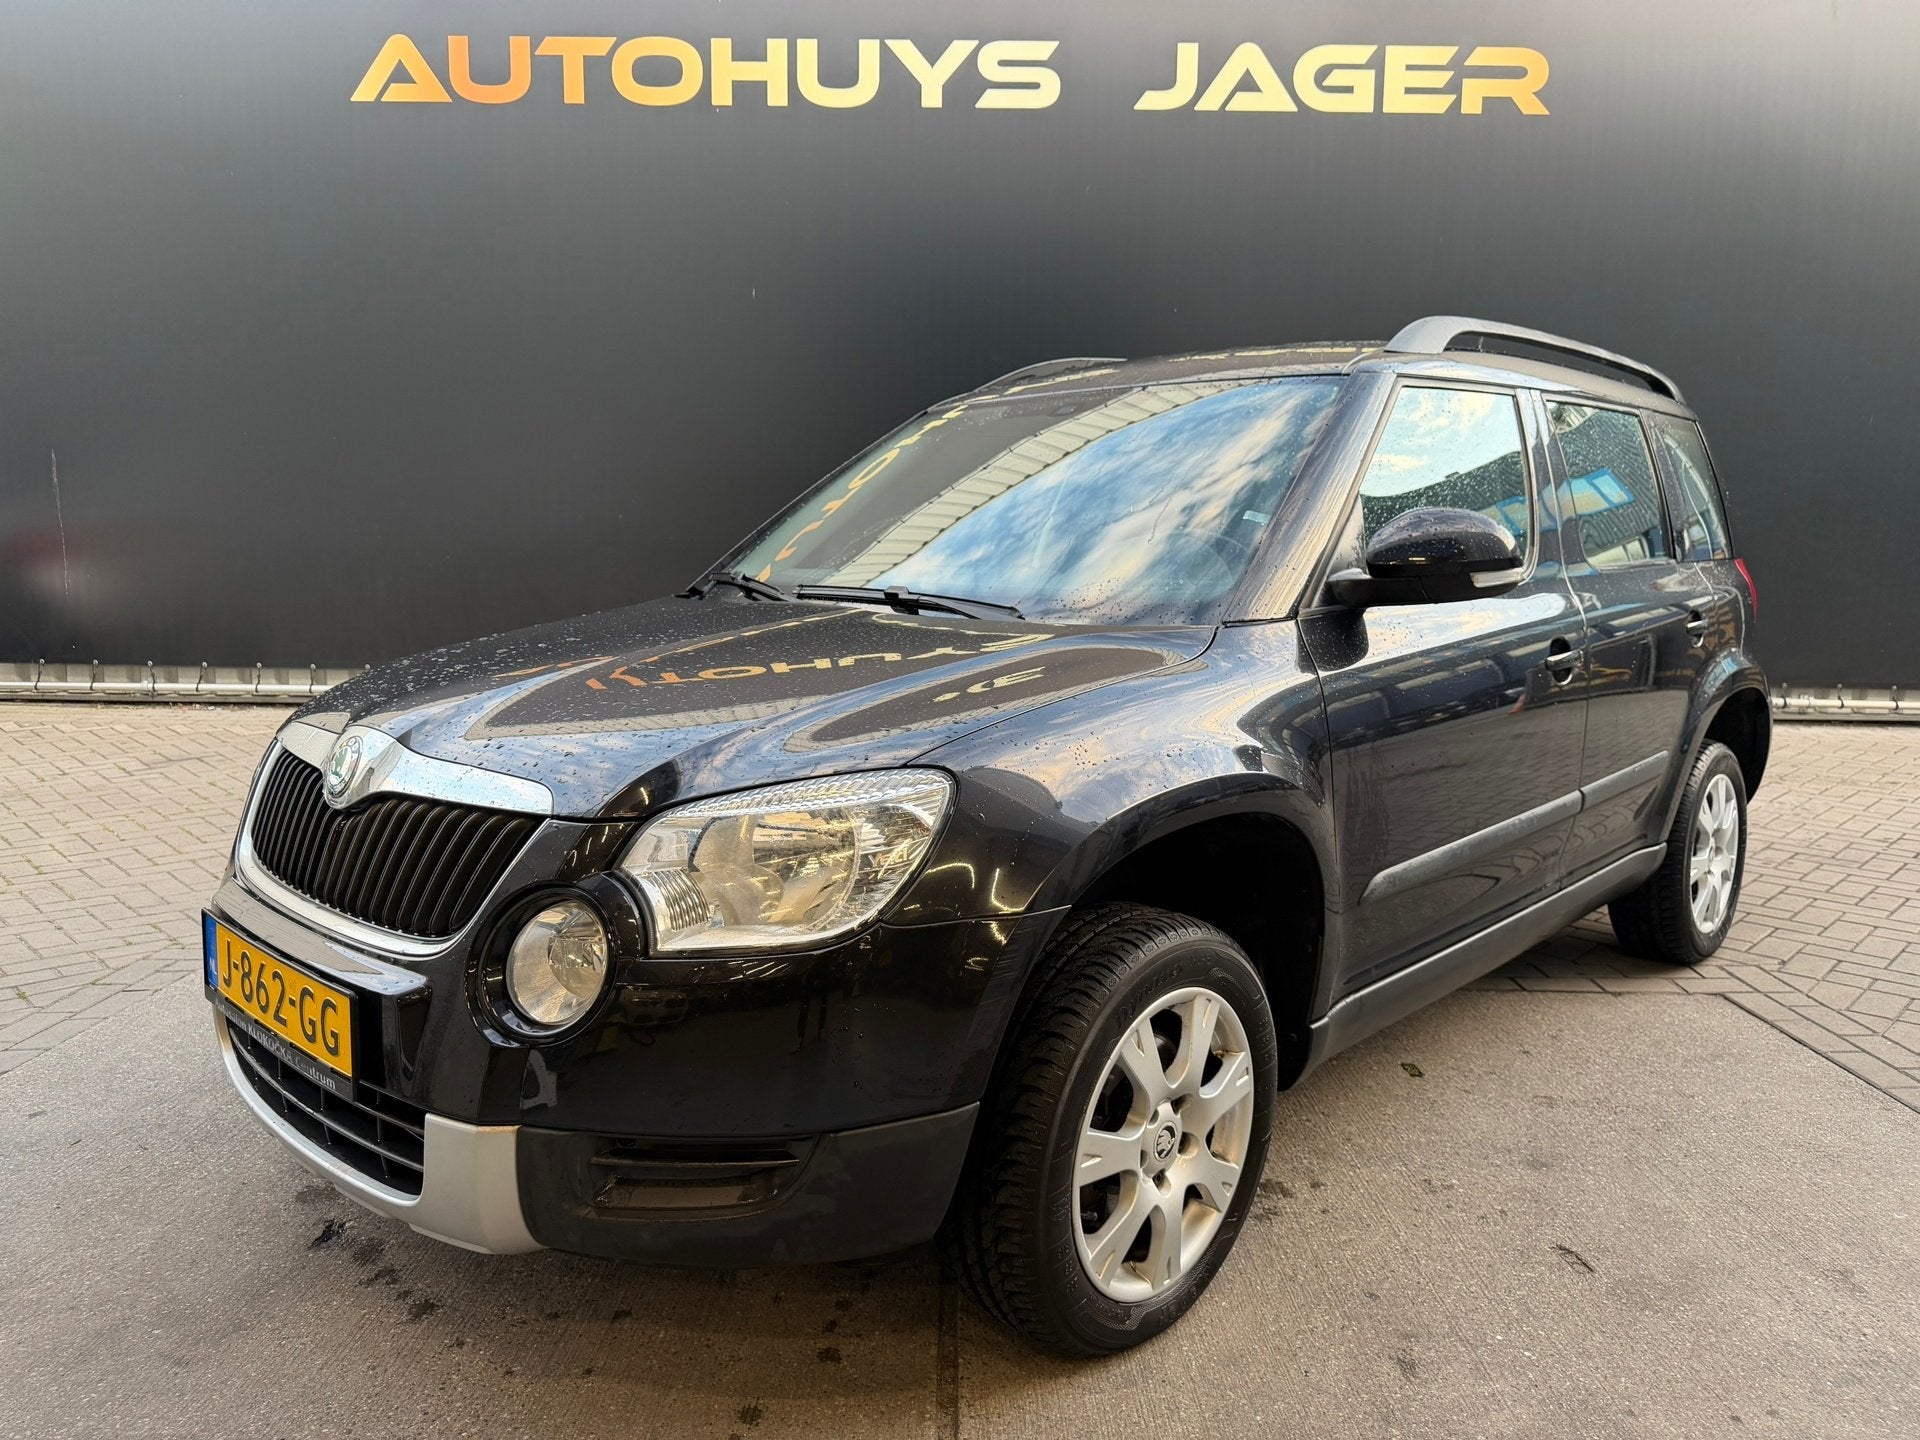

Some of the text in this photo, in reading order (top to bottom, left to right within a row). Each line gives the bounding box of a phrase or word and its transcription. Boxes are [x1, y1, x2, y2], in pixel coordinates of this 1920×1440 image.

[349, 33, 1551, 115] AUTOHUYS JAGER
[222, 938, 339, 1056] J-862-GG
